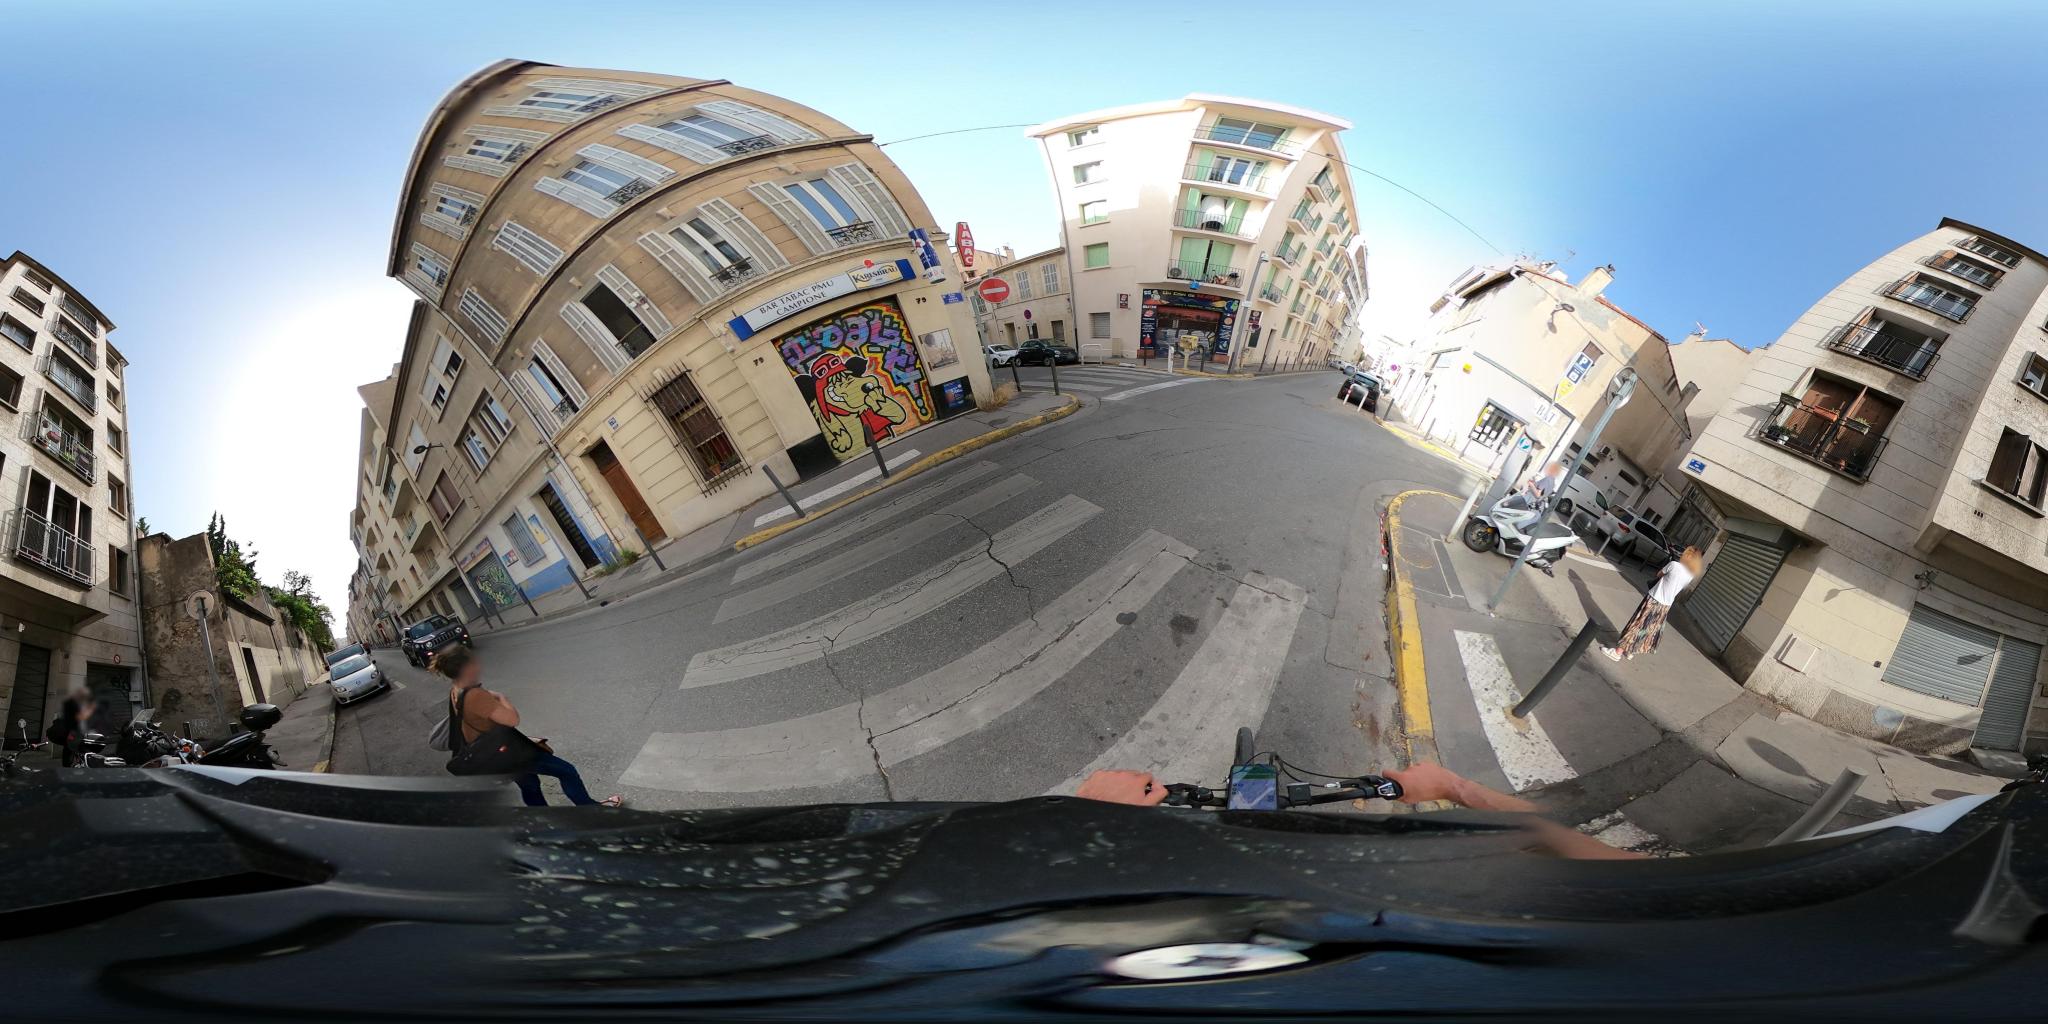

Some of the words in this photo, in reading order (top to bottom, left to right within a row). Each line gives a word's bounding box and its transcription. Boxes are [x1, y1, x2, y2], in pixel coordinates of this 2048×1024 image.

[960, 222, 974, 264] TABAC
[759, 302, 779, 314] BAR
[779, 288, 811, 304] TABAC
[811, 280, 834, 292] PMU
[776, 291, 828, 316] CAMPIONE
